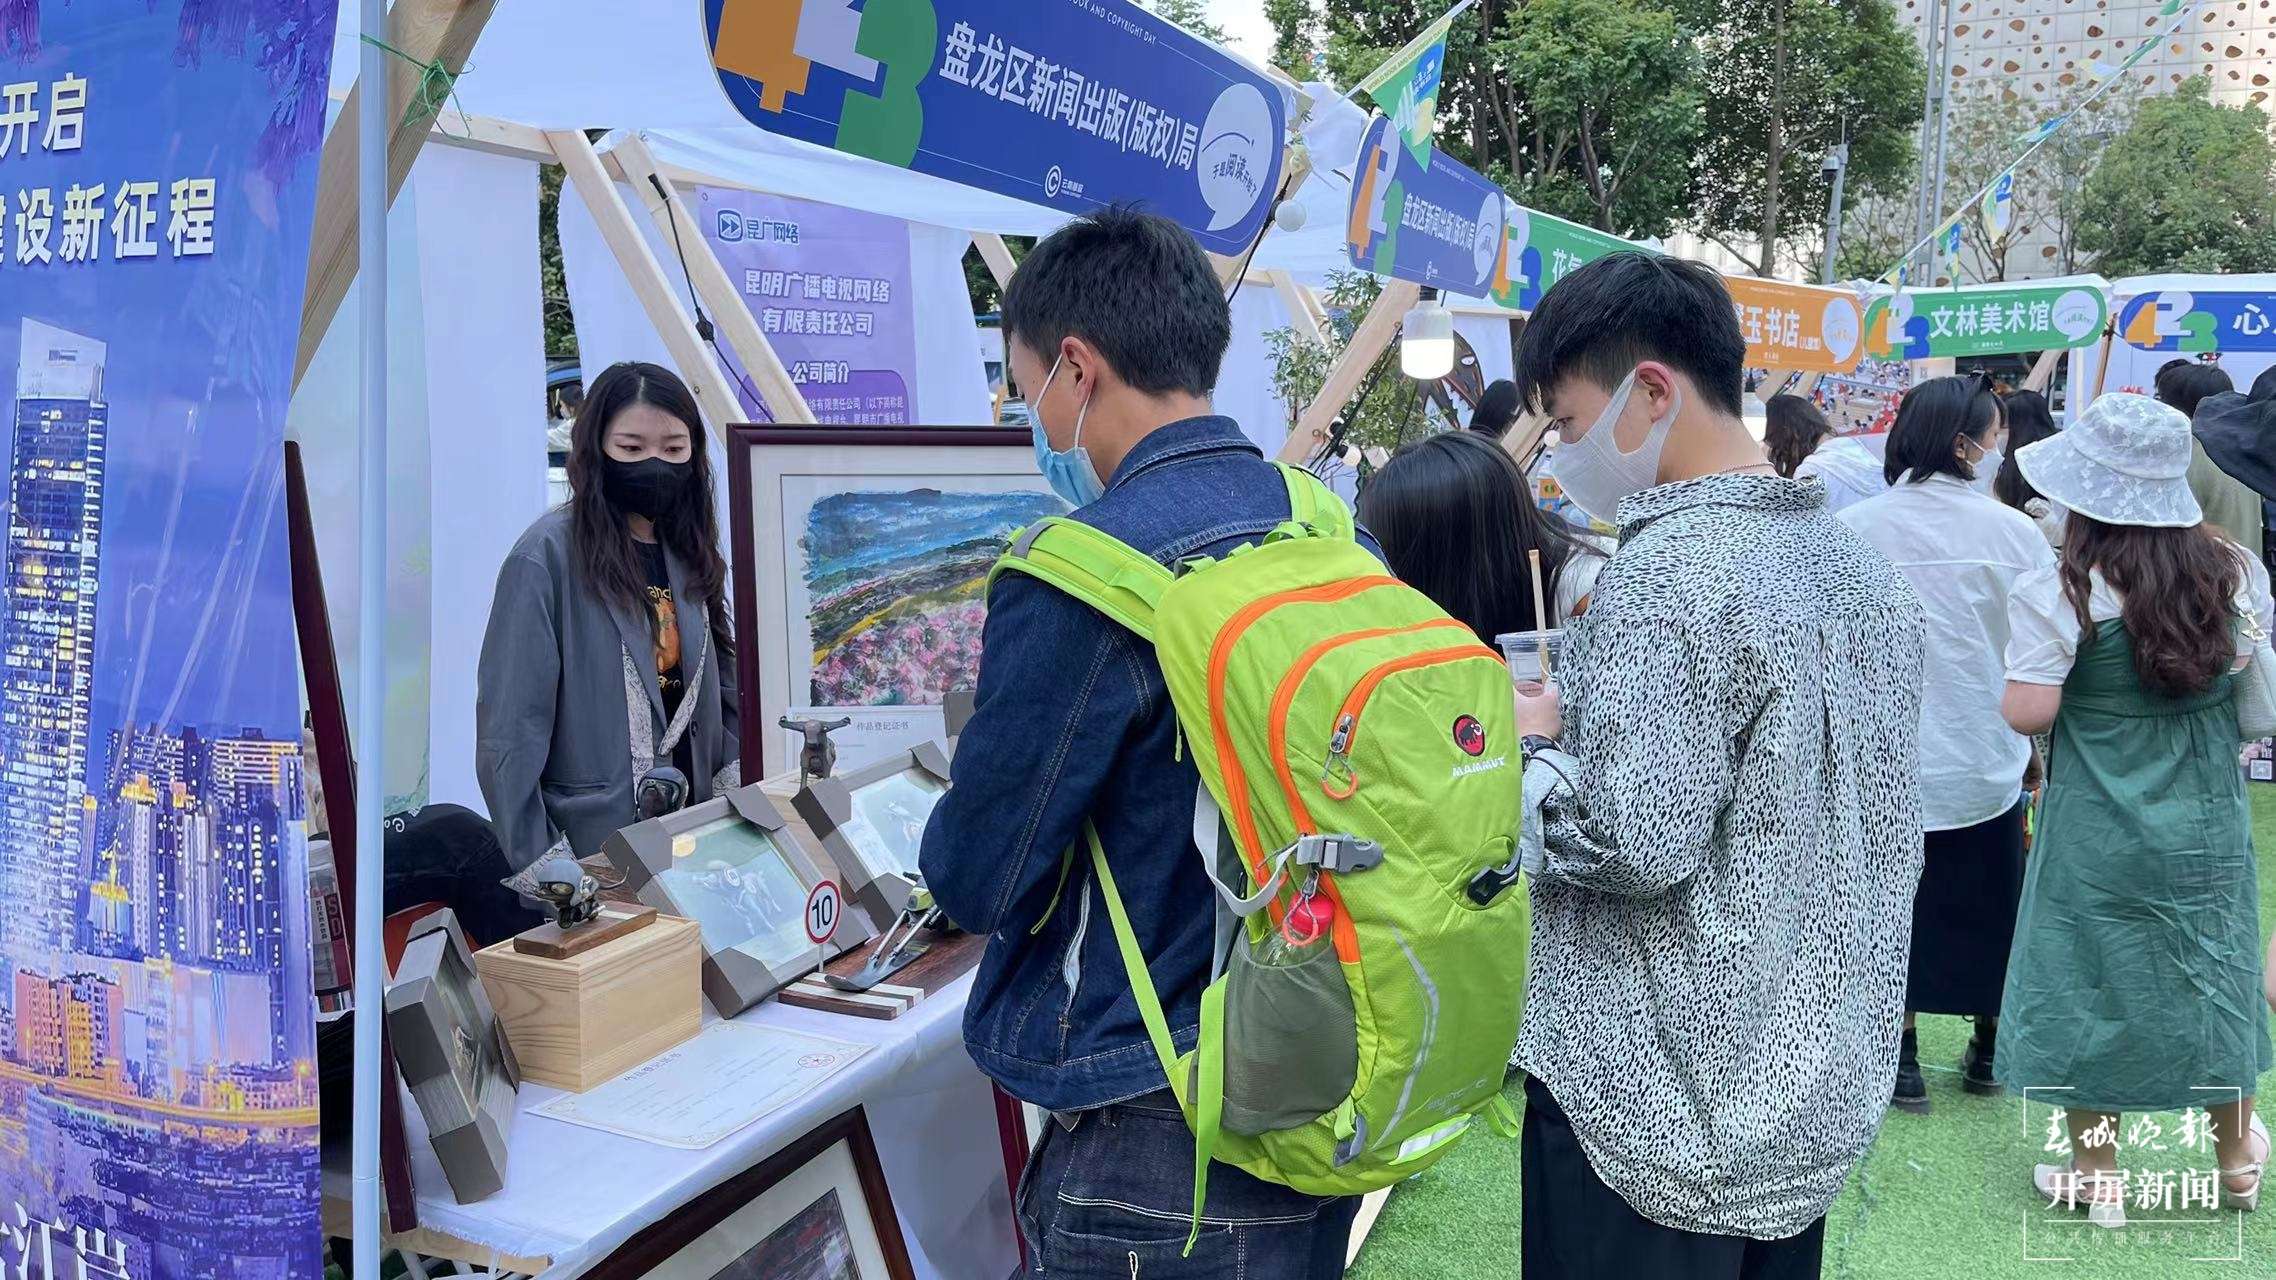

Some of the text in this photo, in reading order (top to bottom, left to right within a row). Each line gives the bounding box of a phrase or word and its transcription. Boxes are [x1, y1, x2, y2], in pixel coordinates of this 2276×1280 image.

[1089, 3, 1105, 18] AND
[1107, 11, 1144, 38] COPYRIGHT
[1144, 31, 1157, 45] DAY
[938, 20, 1199, 171] 盘龙区新闻出版(版权)局
[0, 72, 88, 158] 开启
[0, 177, 216, 264] 设新征程
[746, 218, 800, 244] 昆广网络
[744, 268, 891, 304] 昆明广播电视网络
[762, 307, 875, 337] 有限责任公司
[1929, 300, 2051, 339] 文林美术馆
[2232, 303, 2276, 336] 心
[791, 361, 850, 384] 公司简介
[1452, 757, 1505, 777] MAMMUT
[812, 895, 833, 930] 10
